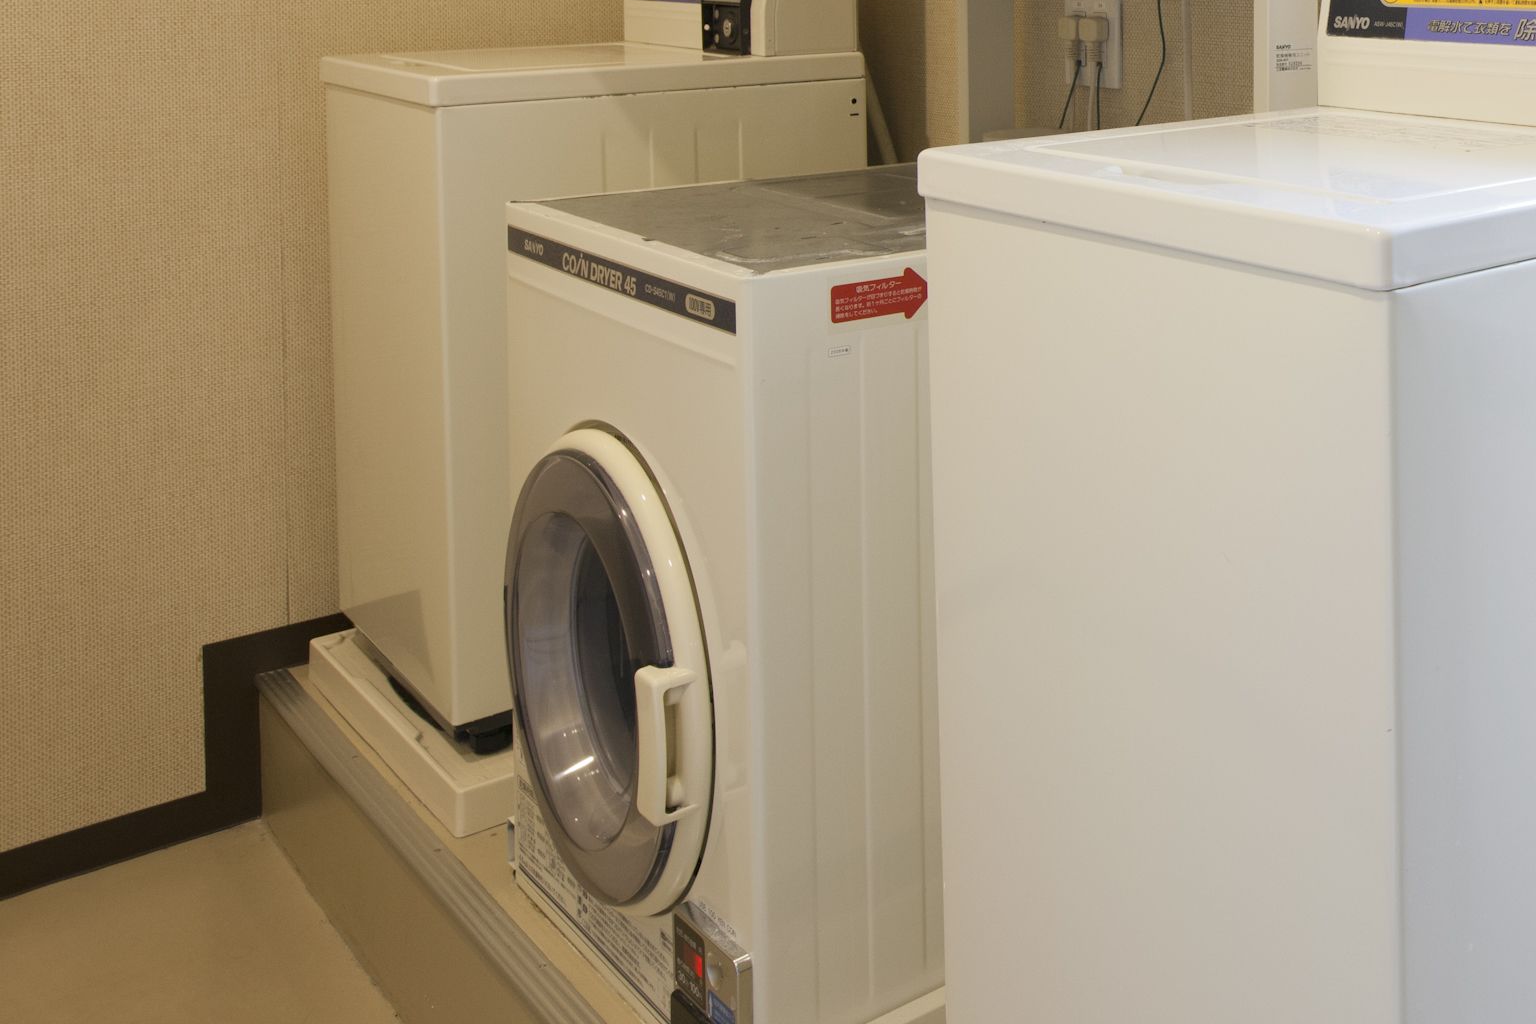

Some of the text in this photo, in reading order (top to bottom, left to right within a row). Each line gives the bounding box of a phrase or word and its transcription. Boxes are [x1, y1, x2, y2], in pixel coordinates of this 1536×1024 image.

[1333, 15, 1371, 30] SANYO
[524, 239, 544, 257] SANYO
[562, 252, 638, 297] COIN DRYER 45
